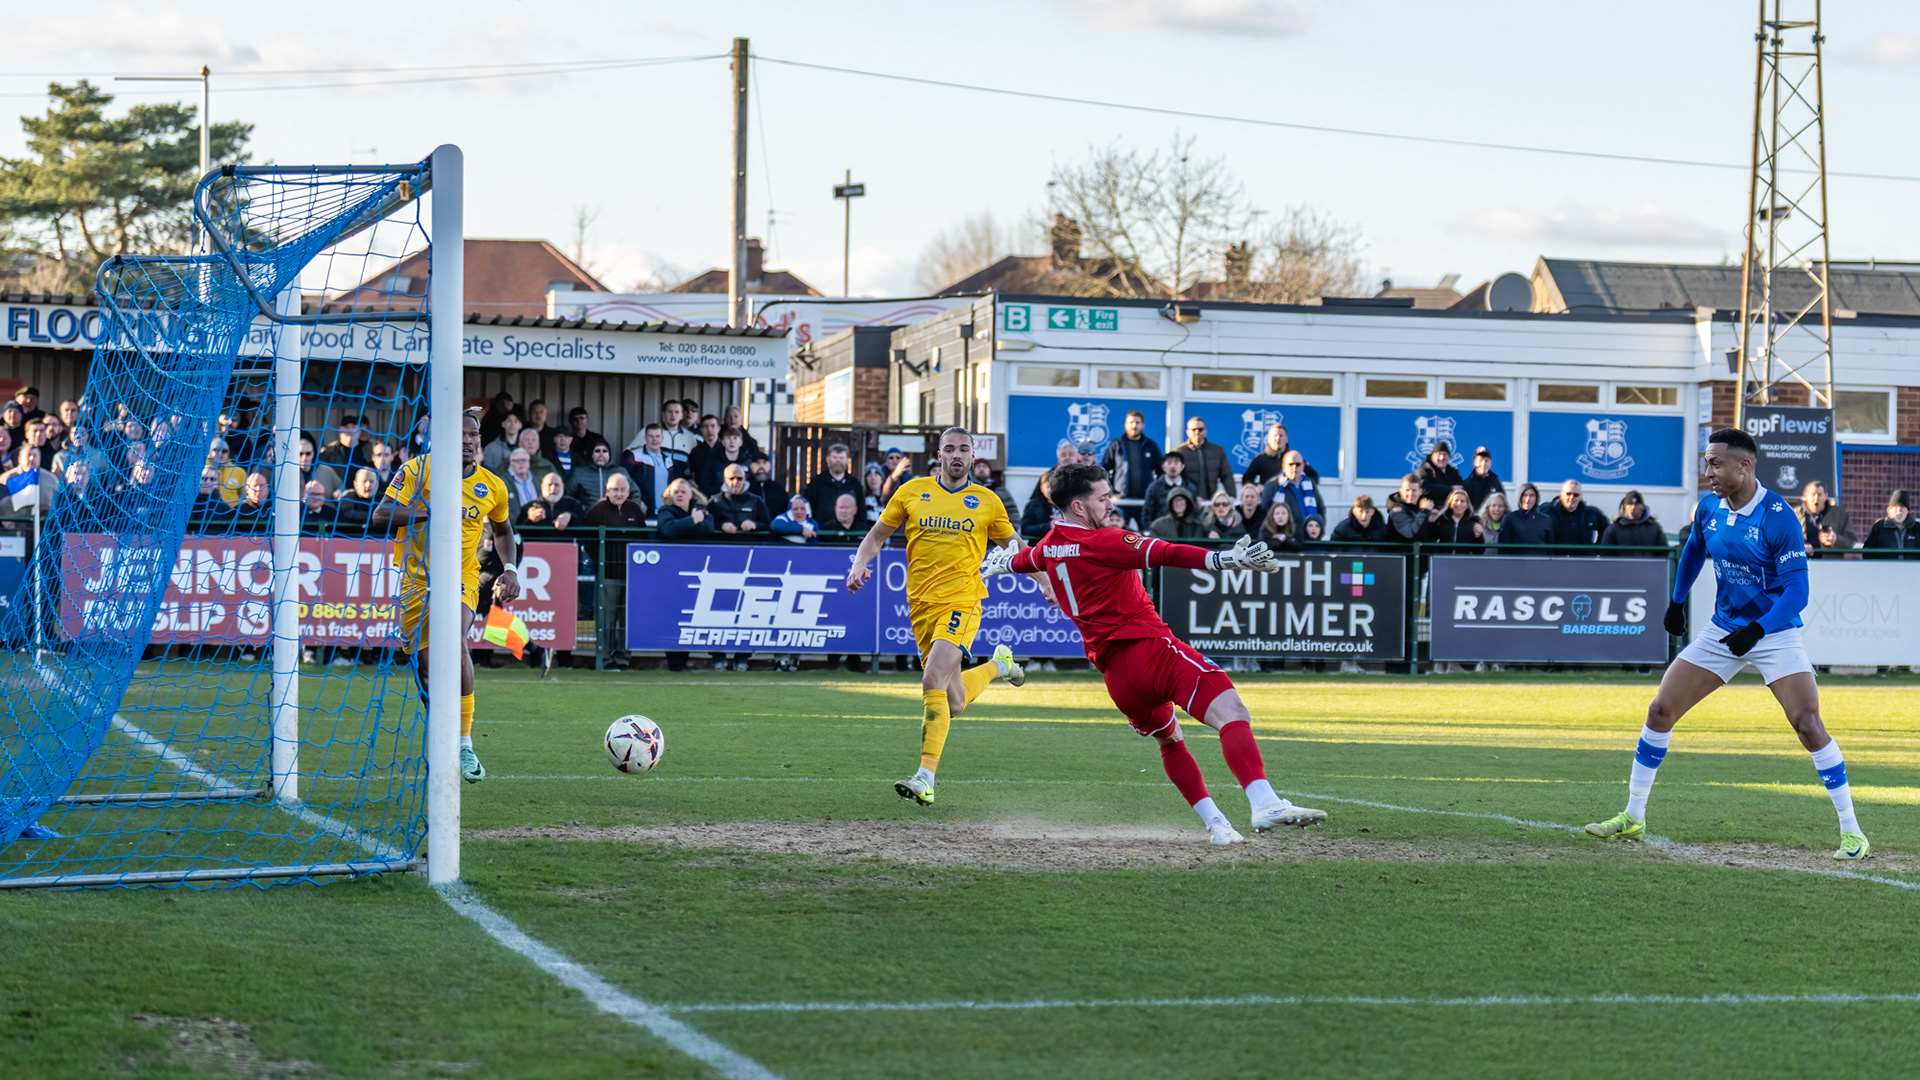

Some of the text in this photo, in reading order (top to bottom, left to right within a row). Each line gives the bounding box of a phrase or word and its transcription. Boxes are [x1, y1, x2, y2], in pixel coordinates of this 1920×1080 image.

[1007, 307, 1027, 330] B
[1095, 310, 1115, 320] Fire
[1095, 321, 1114, 330] exit
[364, 329, 383, 350] &
[392, 331, 493, 356] Lamate
[503, 335, 615, 362] Specialists
[658, 342, 756, 356] Tel: 020 8424 0800
[637, 354, 776, 369] www.nagleflooring.co.uk
[1746, 413, 1828, 437] gpflewis
[919, 516, 961, 530] utilita
[1190, 560, 1332, 597] SMITH
[1055, 562, 1079, 617] 1
[313, 604, 357, 619] 8805
[360, 605, 396, 620] 3141
[948, 611, 962, 630] 5
[1189, 600, 1375, 637] LATIMER
[1803, 592, 1900, 632] XIOM
[316, 625, 325, 637] a
[328, 622, 362, 640] fast,
[678, 628, 846, 647] SCAFFOLDING LTD
[1562, 623, 1646, 635] BARBERSHOP
[1189, 637, 1374, 653] www.smithandlatimer.co.uk
